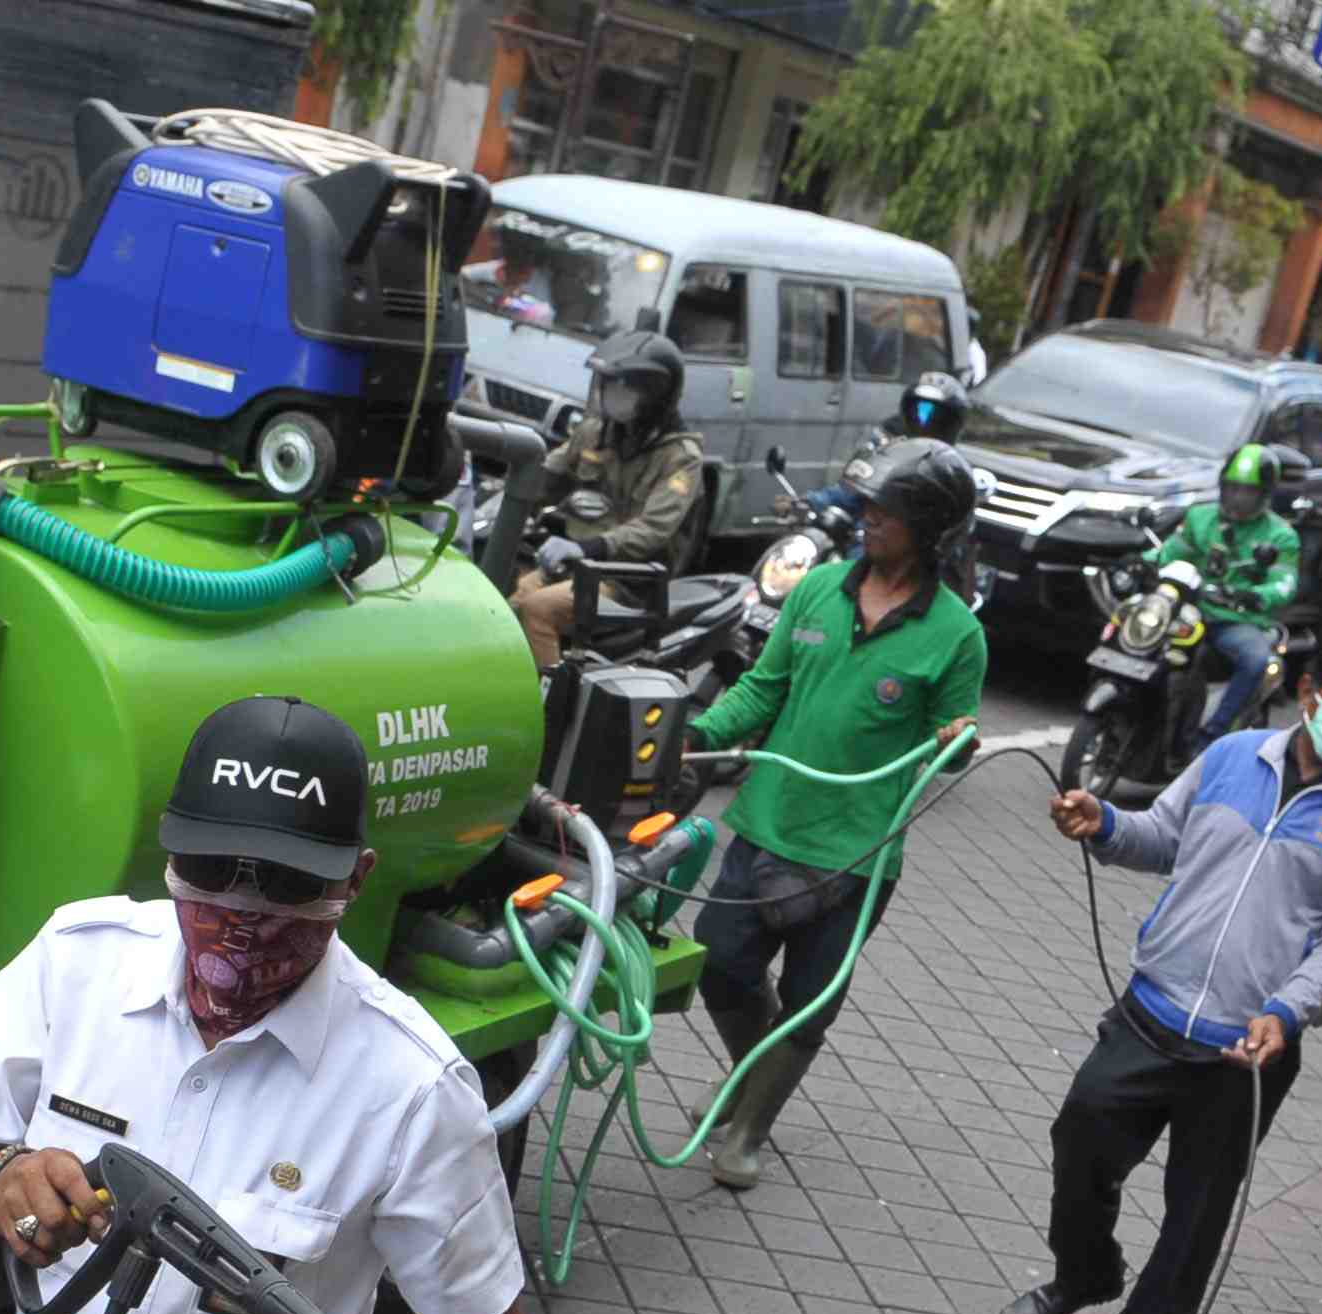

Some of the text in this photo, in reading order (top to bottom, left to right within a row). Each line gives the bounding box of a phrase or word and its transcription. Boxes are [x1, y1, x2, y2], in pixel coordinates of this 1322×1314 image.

[149, 166, 204, 200] YAMAHA
[376, 703, 450, 748] DLHK
[211, 757, 327, 807] RVCA
[390, 744, 489, 784] DENPASAR
[375, 786, 444, 819] TA 2019
